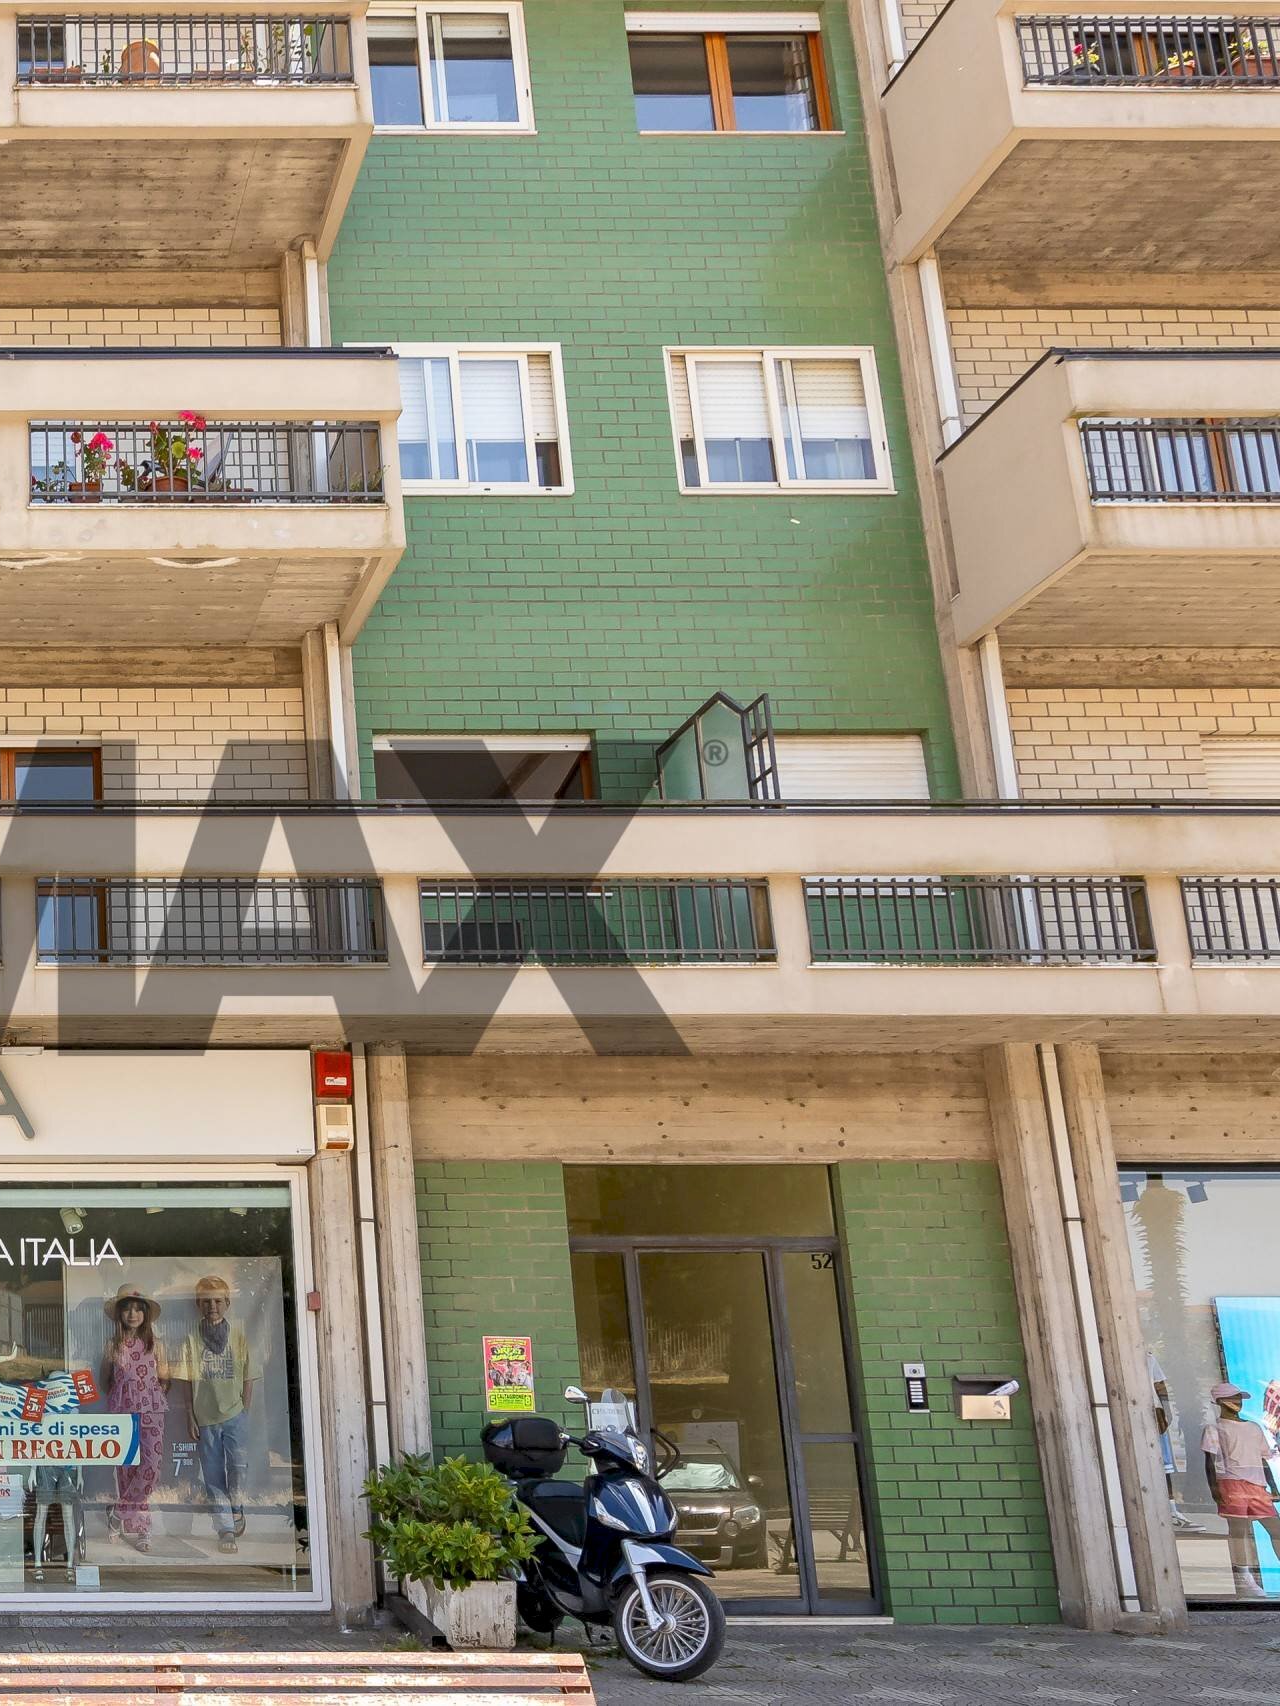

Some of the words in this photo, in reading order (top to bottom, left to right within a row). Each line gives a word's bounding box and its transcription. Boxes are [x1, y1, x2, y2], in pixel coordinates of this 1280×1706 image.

[21, 1238, 124, 1266] ITALIA
[811, 1253, 833, 1270] 52
[20, 1423, 43, 1436] 5€
[48, 1421, 65, 1436] di
[70, 1424, 120, 1440] spesa
[11, 1439, 121, 1460] REGALO
